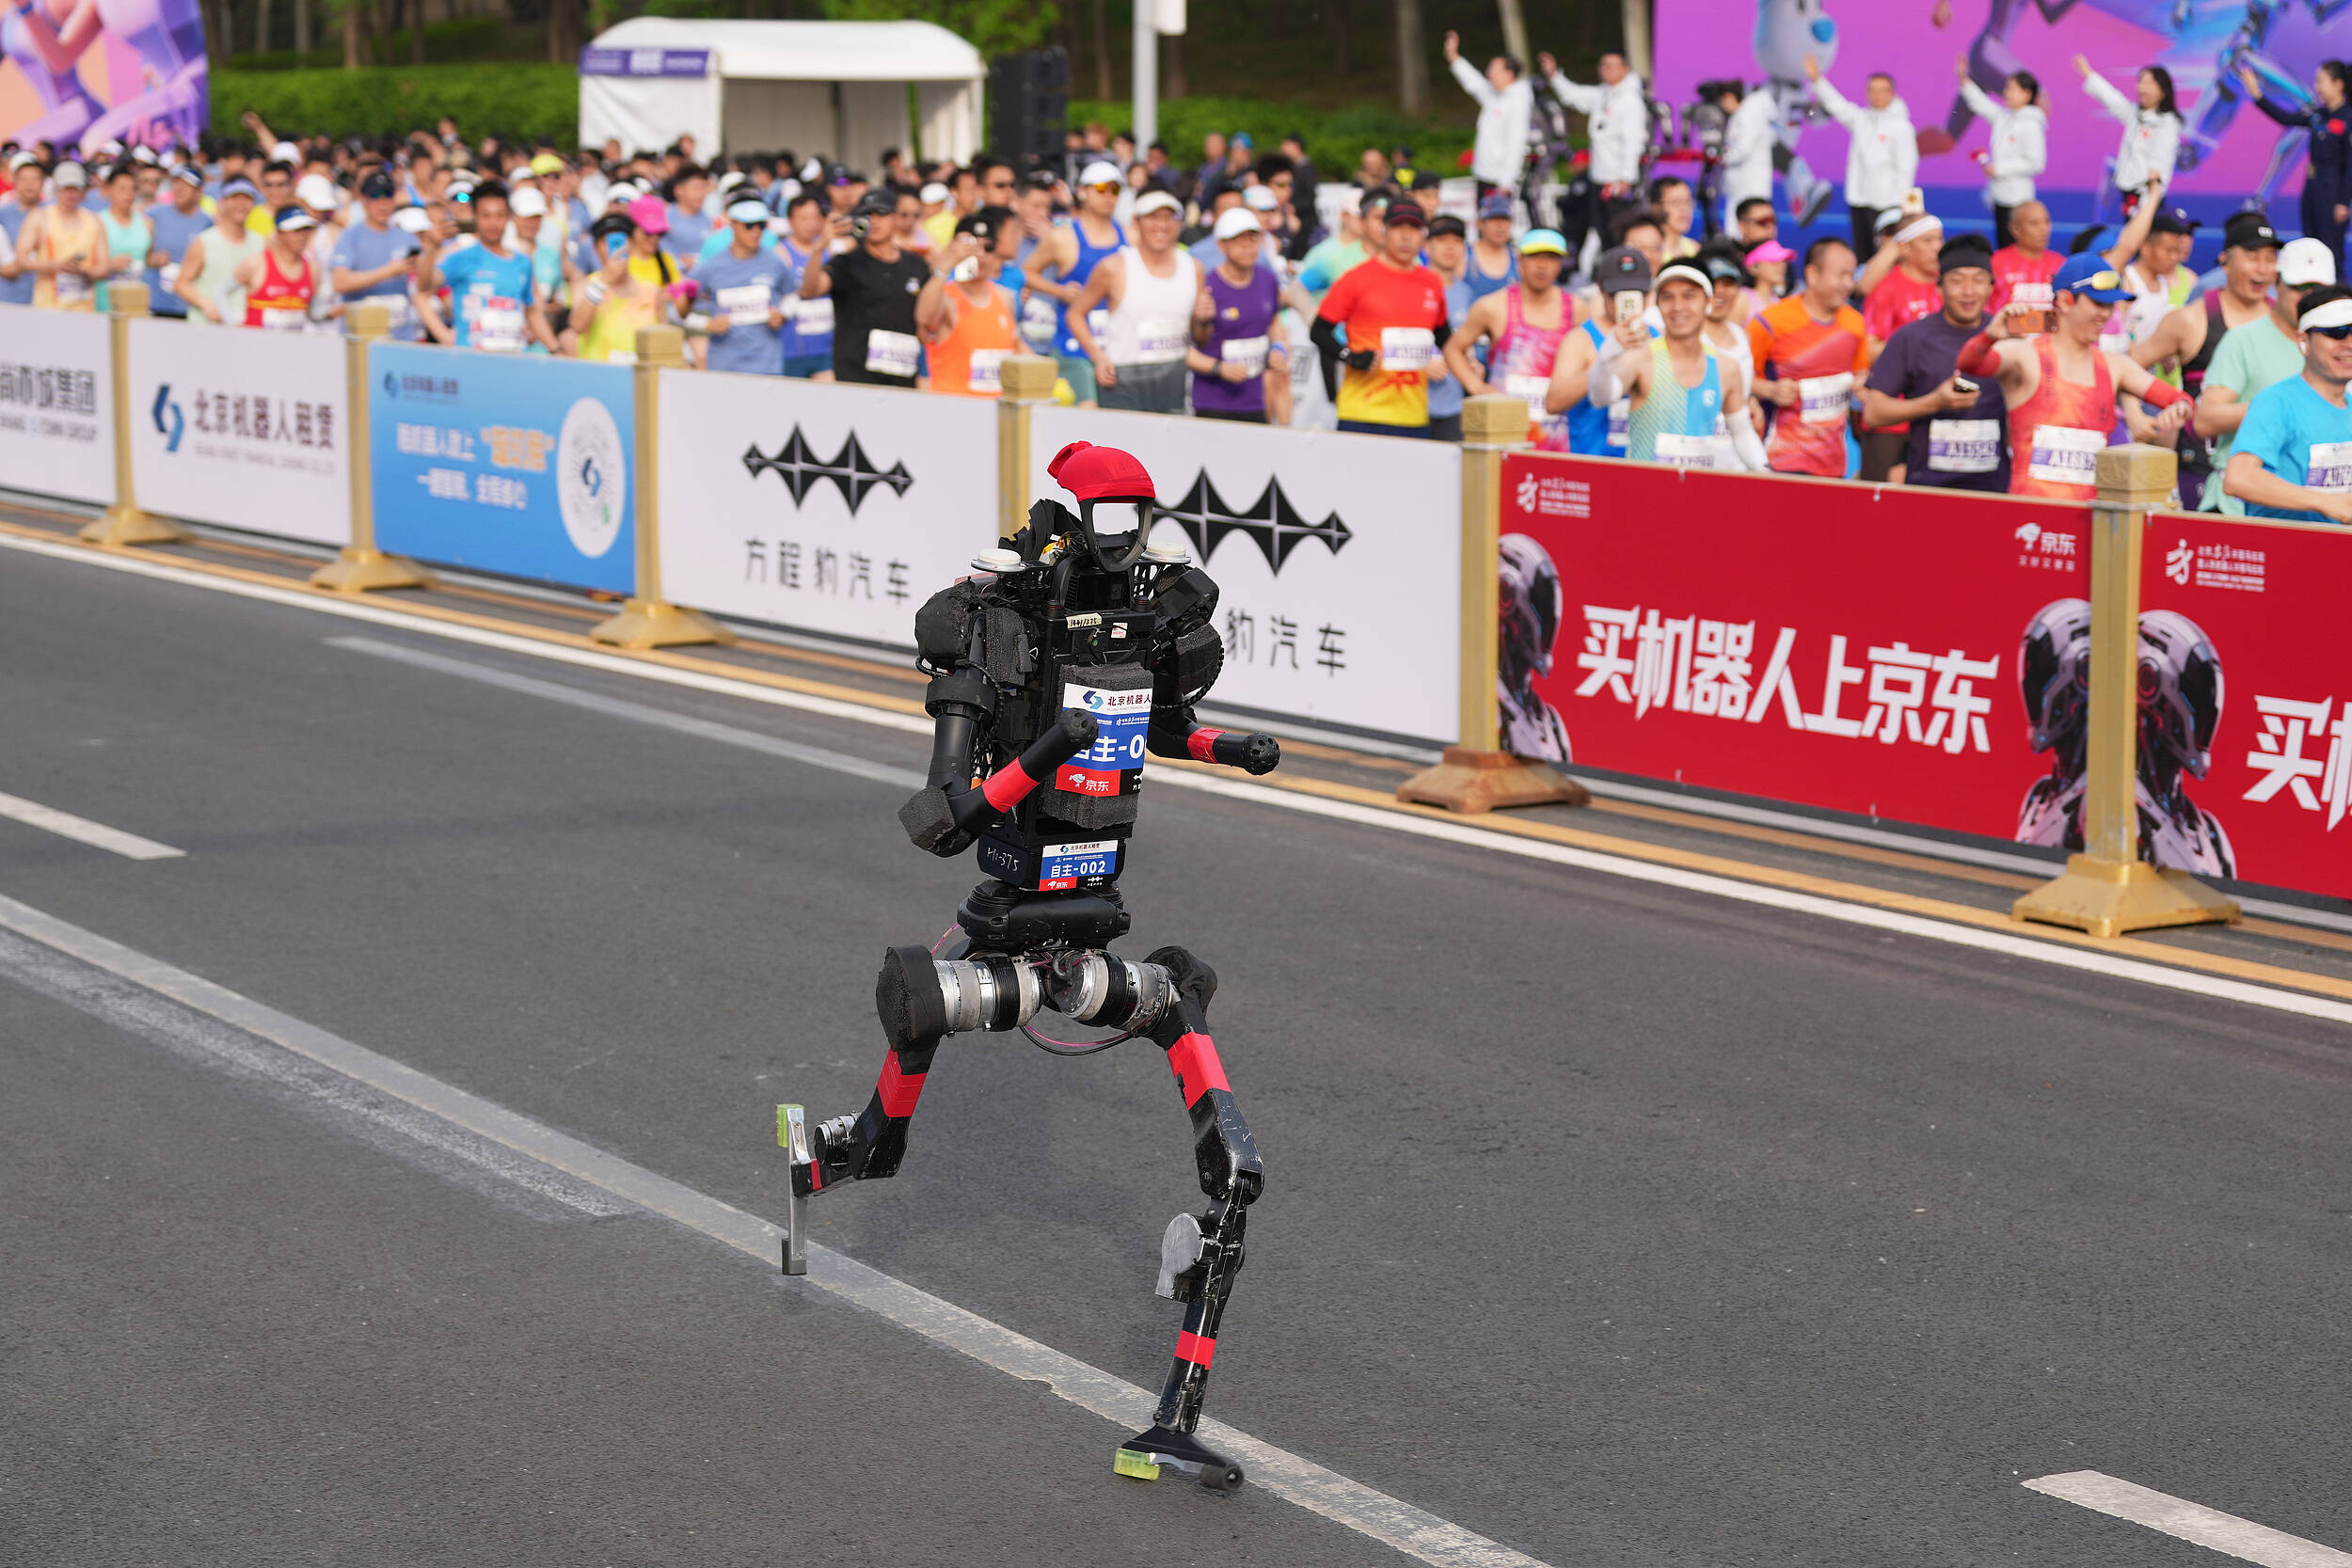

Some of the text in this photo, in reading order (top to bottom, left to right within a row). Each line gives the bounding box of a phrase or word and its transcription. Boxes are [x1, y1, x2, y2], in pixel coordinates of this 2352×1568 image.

[195, 388, 334, 450] 北京机器人租赁
[2041, 531, 2076, 557] 京东
[745, 537, 910, 607] 方程豹汽车
[1225, 609, 1345, 678] 豹汽车
[1574, 604, 2000, 754] 买机器人上京东
[1107, 693, 1152, 706] 北京机器人
[1073, 734, 1148, 763] 主-0
[1085, 779, 1110, 792] 京东
[1050, 860, 1106, 879] 自主-002
